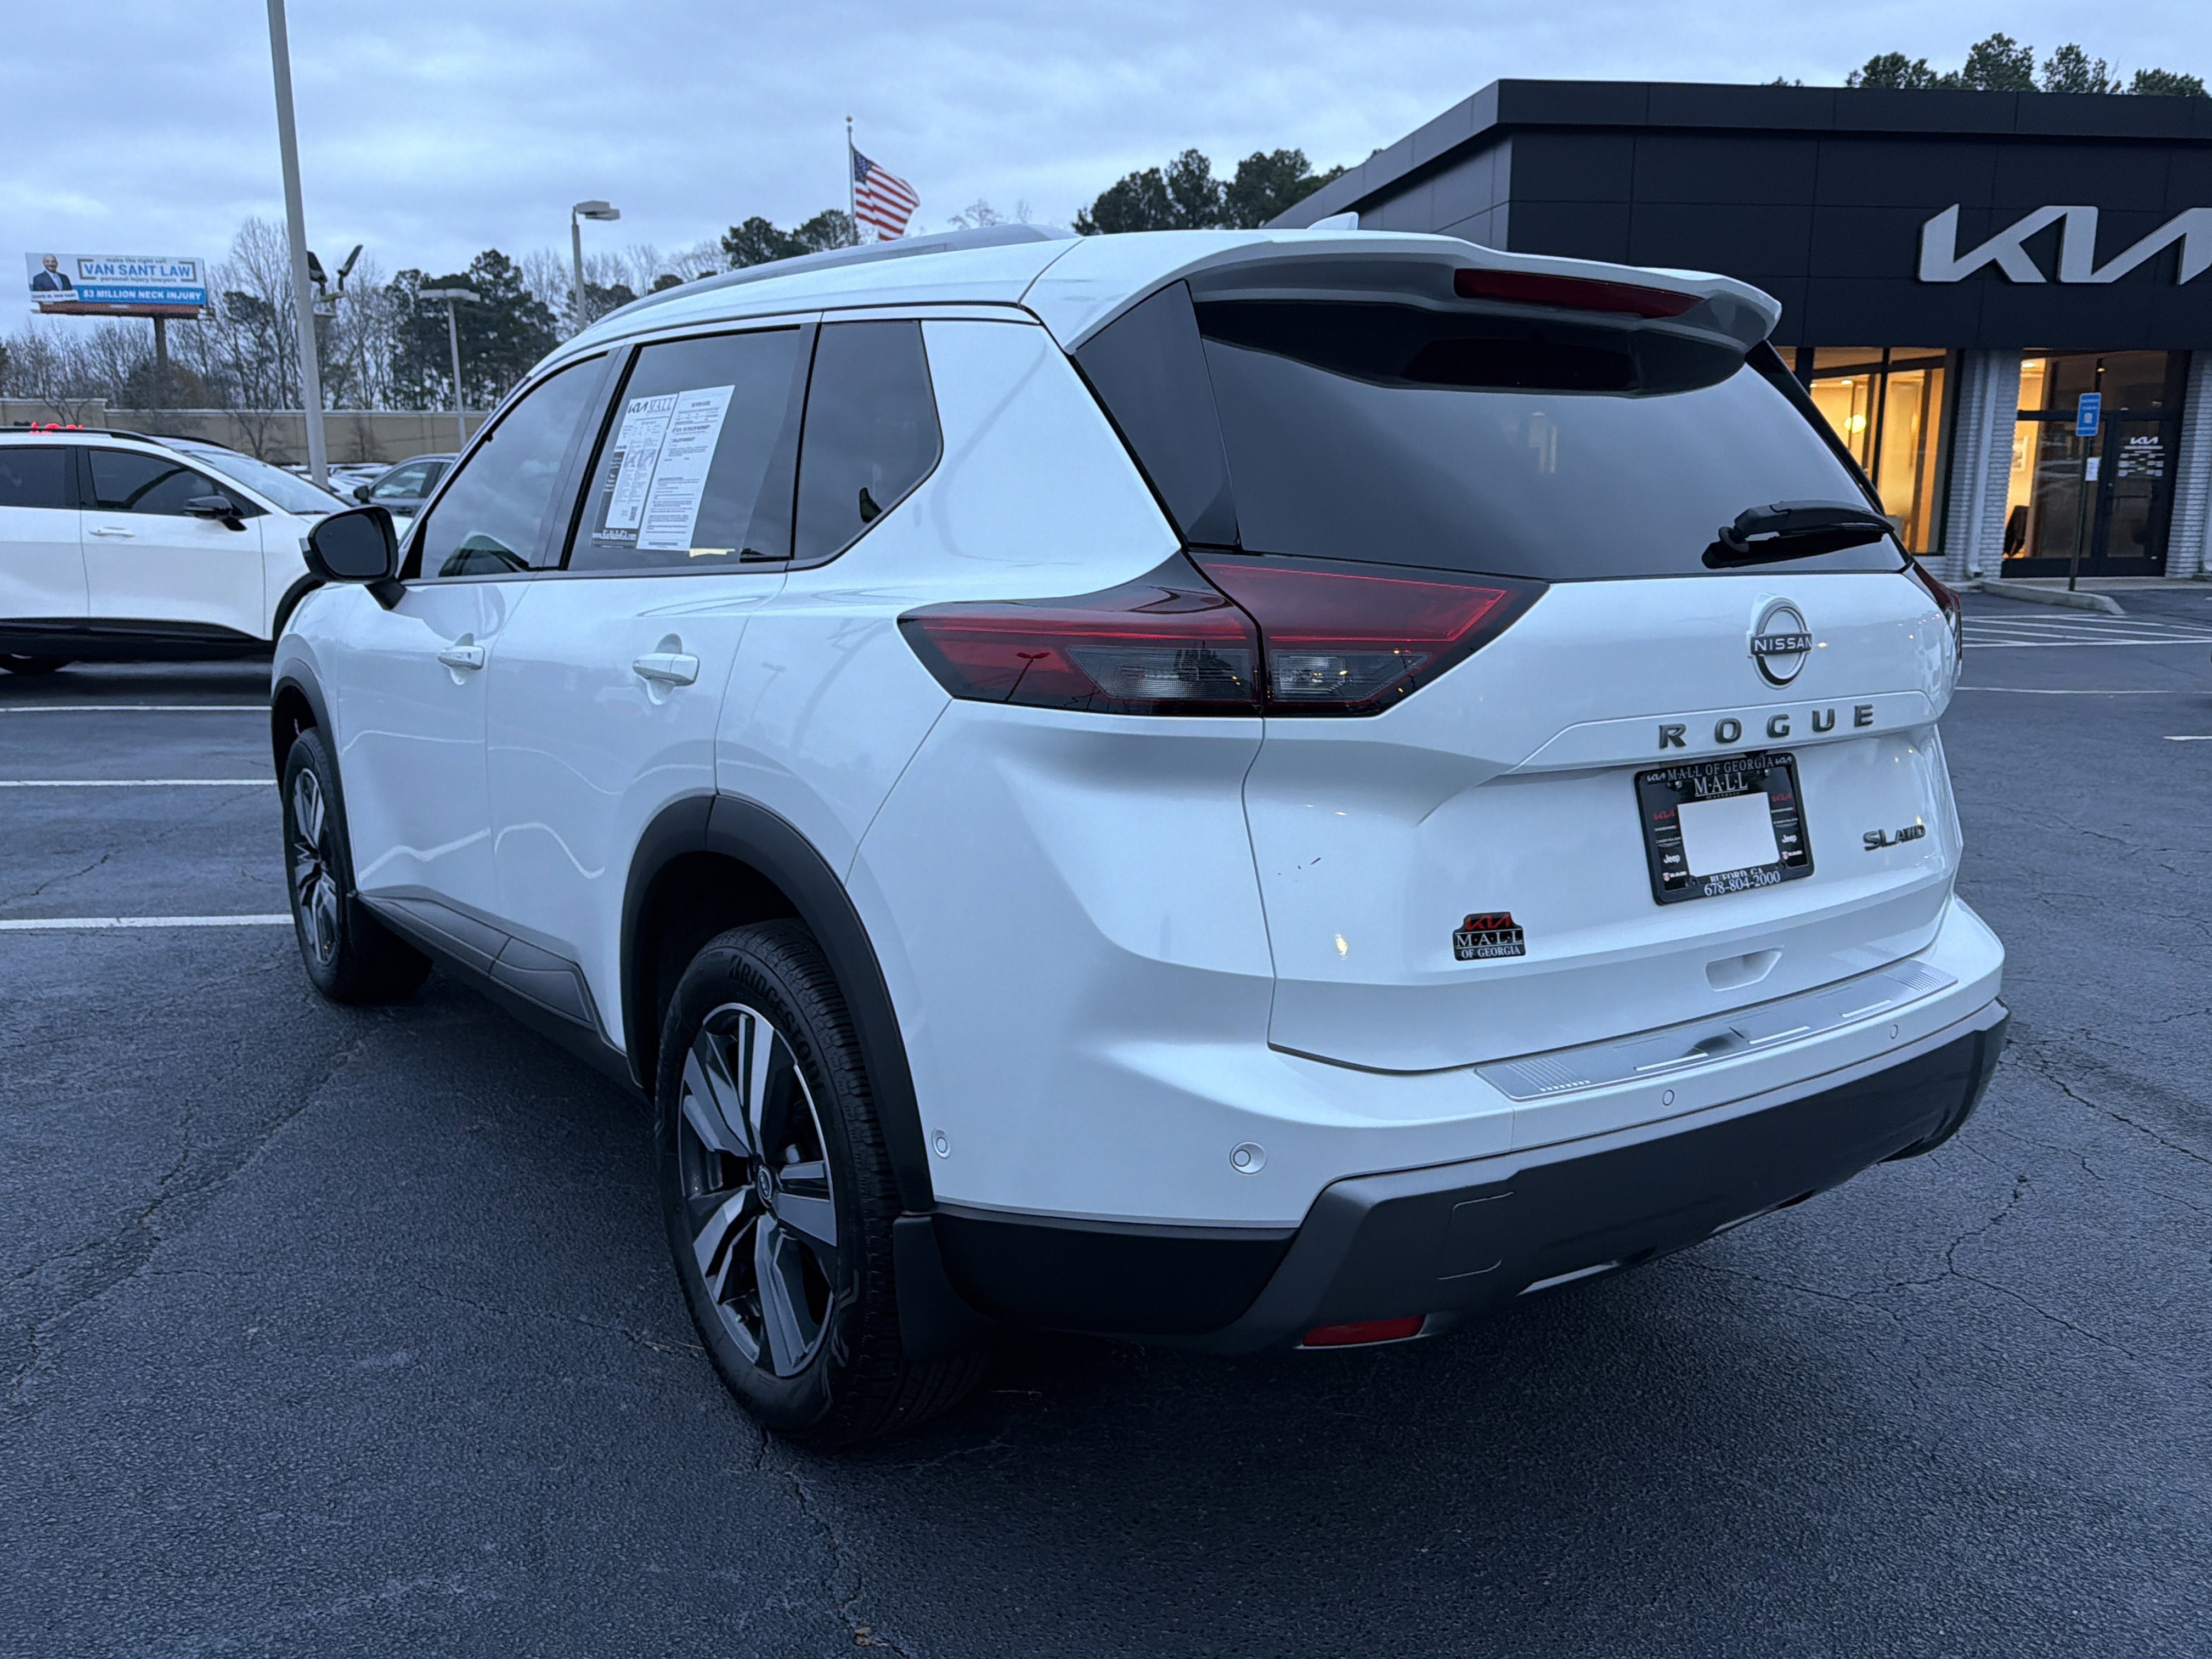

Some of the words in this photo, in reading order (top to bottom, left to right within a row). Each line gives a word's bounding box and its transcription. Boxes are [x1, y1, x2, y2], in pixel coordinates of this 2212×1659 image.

[1920, 203, 2212, 285] KIA
[83, 263, 114, 275] VAN
[118, 264, 156, 276] SANT
[160, 266, 190, 276] LAW
[96, 290, 136, 299] MILLION
[138, 291, 165, 299] NECK
[166, 291, 201, 300] INJURY
[1754, 636, 1813, 652] NISSAN
[1658, 704, 1874, 749] ROGUE
[1646, 772, 1666, 782] KIA
[1705, 763, 1721, 776] OF
[1724, 757, 1775, 773] GEORGIA
[1775, 756, 1793, 765] KIA
[1781, 834, 1798, 844] Jeep
[1663, 854, 1680, 864] Jeep
[1670, 870, 1688, 878] RAM
[1703, 870, 1781, 896] 678-804-2000
[1465, 913, 1513, 931] KIA
[1461, 949, 1475, 959] OF
[1477, 945, 1521, 958] GEORGIA
